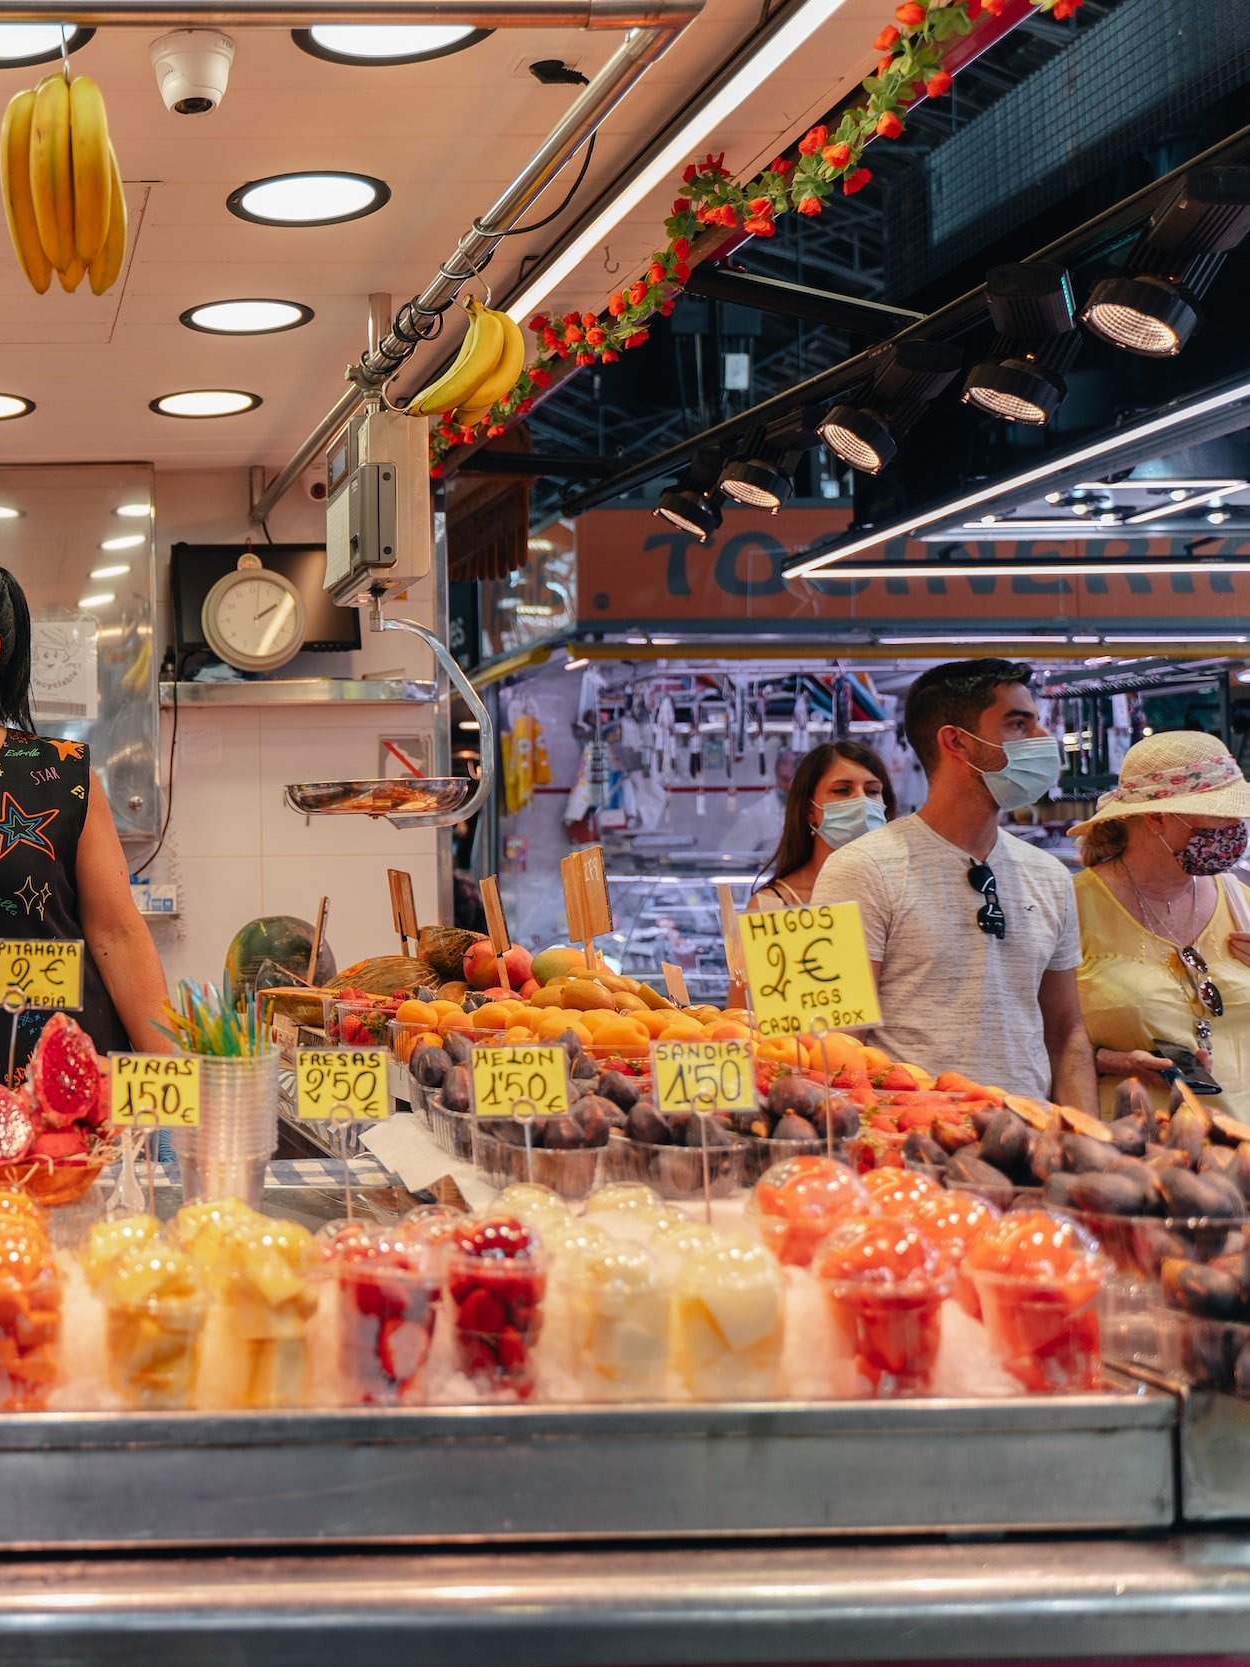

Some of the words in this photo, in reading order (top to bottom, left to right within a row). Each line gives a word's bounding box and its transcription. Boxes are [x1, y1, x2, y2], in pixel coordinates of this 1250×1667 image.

[4, 748, 42, 758] Estrella
[29, 766, 61, 786] STAR
[748, 906, 835, 941] HIGOS
[800, 988, 842, 1010] FIGS
[832, 1010, 866, 1027] BOX
[299, 1052, 381, 1068] FRESAS
[656, 1041, 752, 1061] SANDIAS
[304, 1067, 377, 1104] 2'50
[481, 1071, 547, 1105] 1'50
[663, 1059, 741, 1104] 1'50
